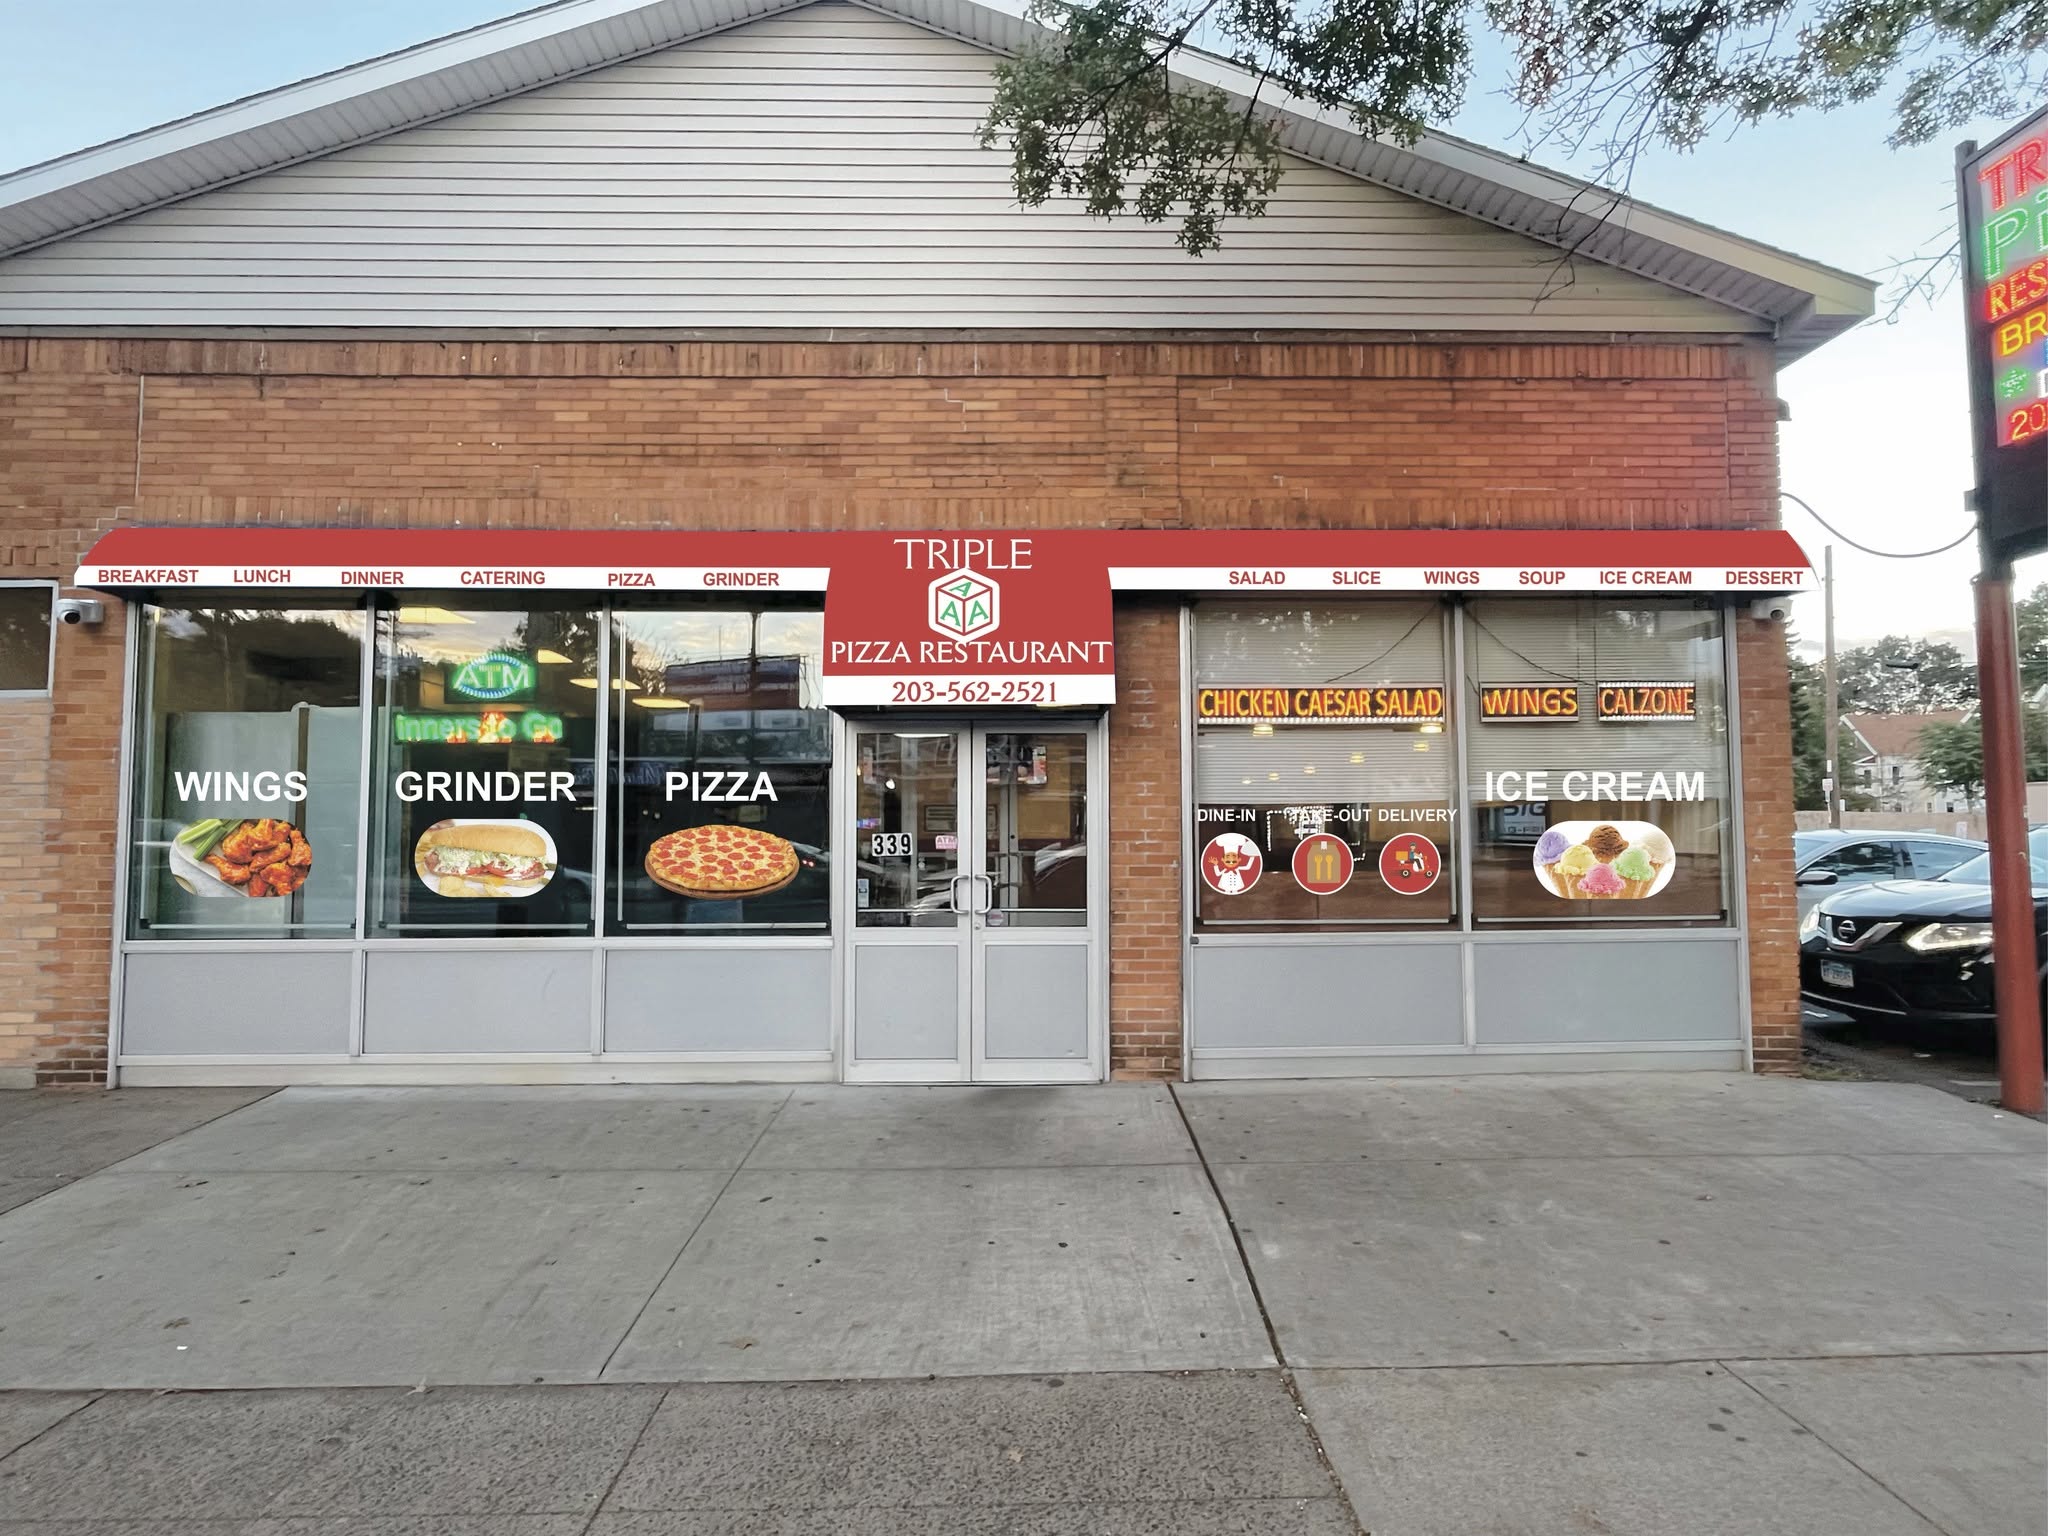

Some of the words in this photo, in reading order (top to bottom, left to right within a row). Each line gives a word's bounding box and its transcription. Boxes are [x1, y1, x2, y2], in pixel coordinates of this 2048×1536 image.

[893, 538, 1033, 569] TRIPLE
[97, 569, 198, 583] BREAKFAST
[233, 569, 291, 584] LUNCH
[341, 571, 404, 585] DINNER
[460, 571, 545, 585] CATERING
[607, 573, 656, 587] PIZZA
[702, 572, 779, 587] GRINDER
[1228, 571, 1286, 585] SALAD
[1332, 571, 1381, 585] SLICE
[1424, 571, 1479, 585] WINGS
[1518, 571, 1566, 585] SOUP
[1599, 571, 1627, 585] ICE
[1632, 571, 1692, 585] CREAM
[1725, 571, 1804, 585] DESSERT
[831, 640, 912, 664] PIZZA
[919, 640, 1113, 664] RESTAURANT
[453, 664, 530, 689] ATM
[892, 680, 1057, 703] 203-562-2521
[1199, 689, 1289, 716] CHICKEN
[1294, 689, 1371, 716] CAESAR
[1374, 689, 1443, 716] SALAD
[1484, 688, 1578, 716] WINGS
[1599, 687, 1695, 715] CALZONE
[174, 770, 308, 802] WINGS
[395, 770, 577, 802] GRINDER
[665, 771, 778, 802] PIZZA
[1486, 771, 1549, 802] ICE
[1562, 771, 1705, 802] CREAM
[1197, 808, 1256, 822] DINE-IN
[1378, 808, 1457, 822] DELIVERY
[873, 833, 911, 855] 339
